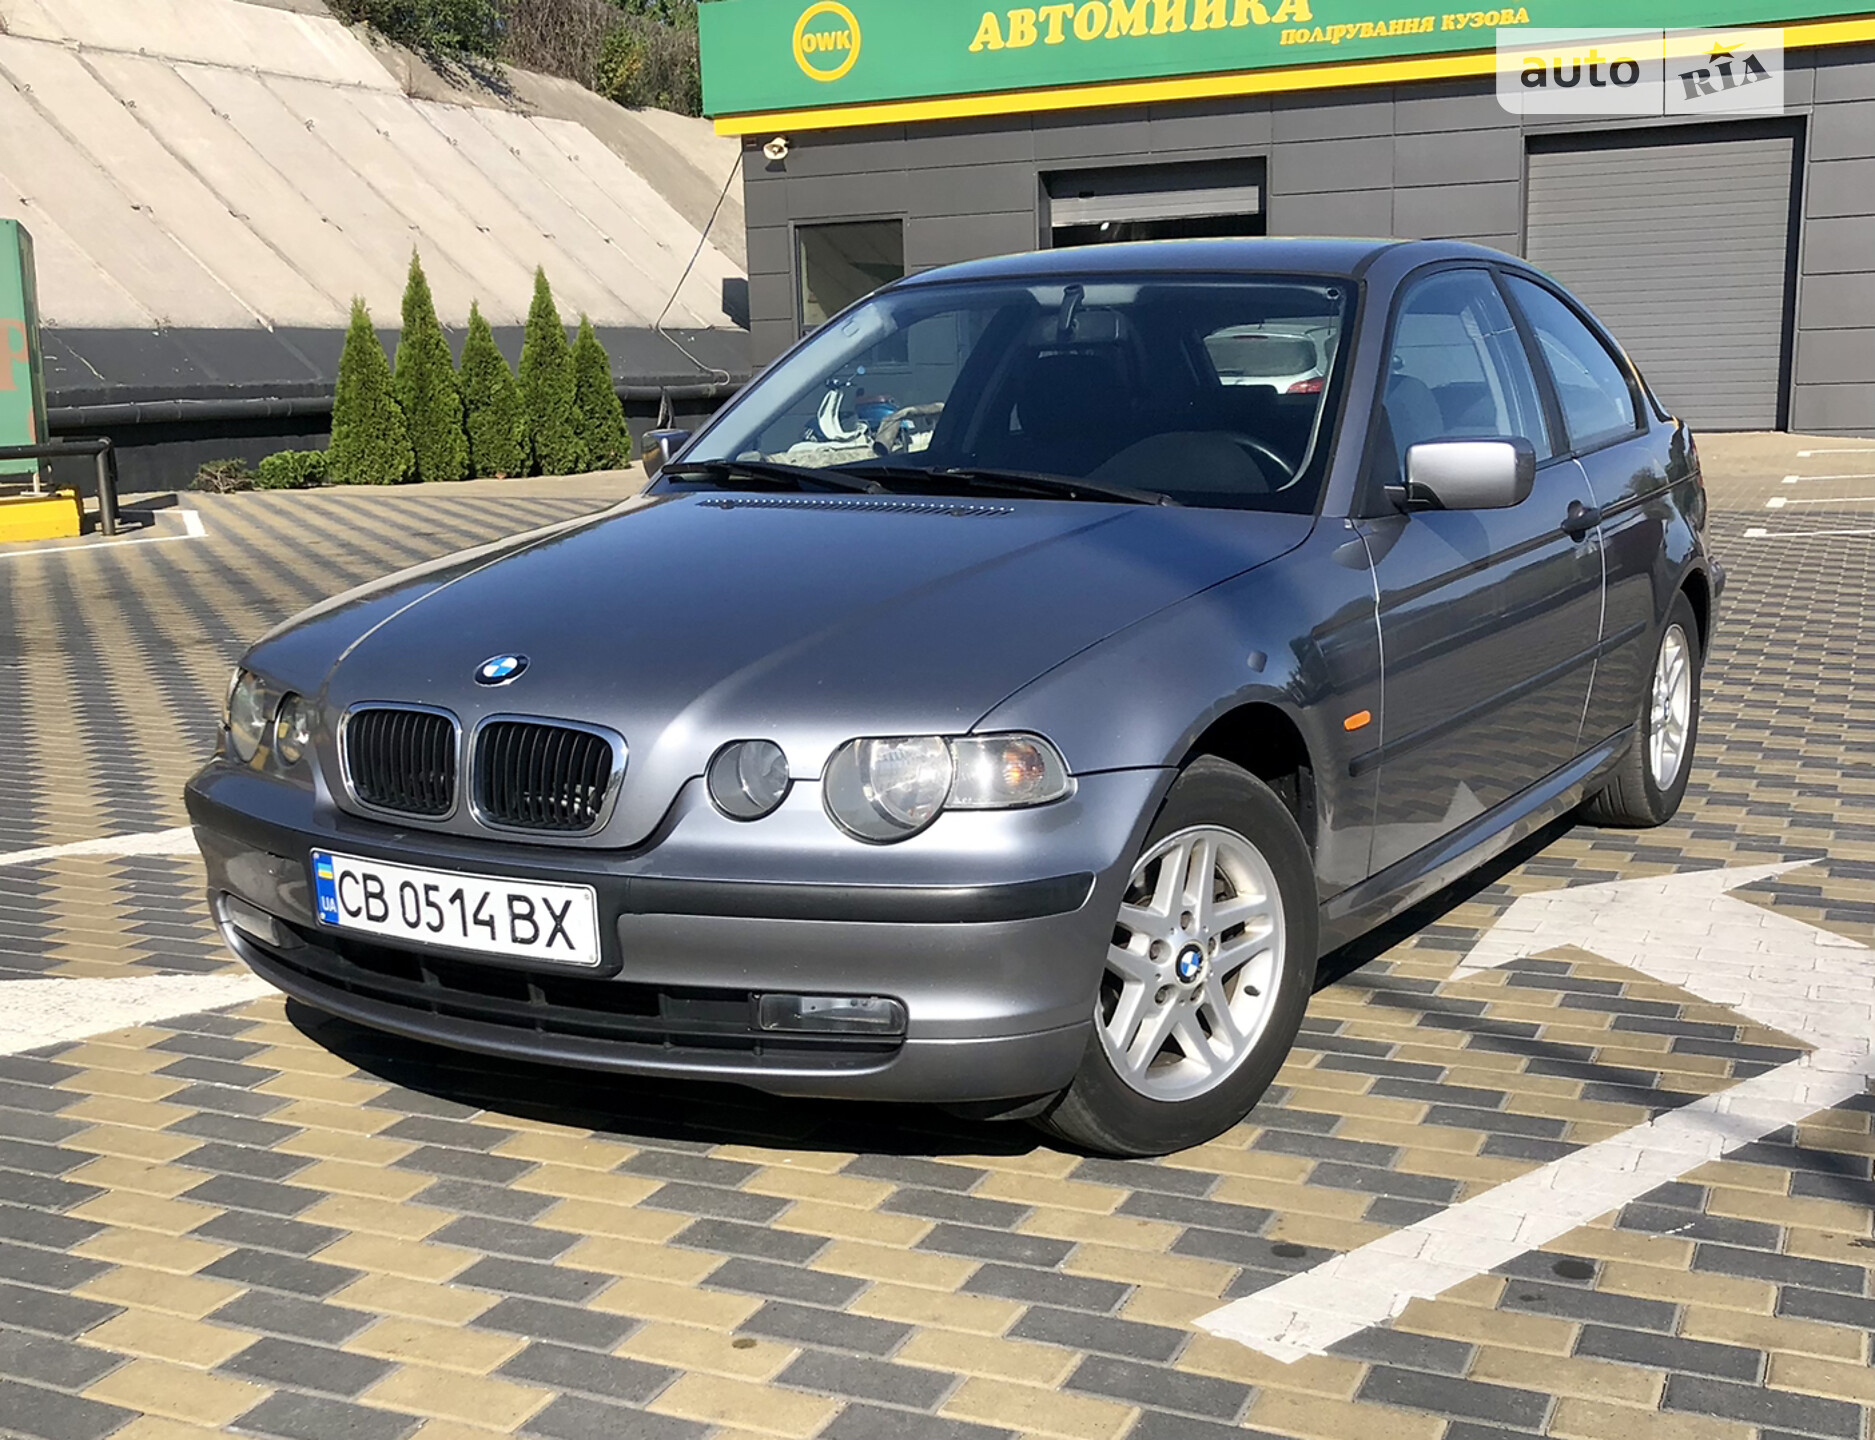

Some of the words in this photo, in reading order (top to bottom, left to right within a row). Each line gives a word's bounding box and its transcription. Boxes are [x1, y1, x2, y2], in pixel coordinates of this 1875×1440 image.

[1441, 7, 1529, 31] КУЗОВА
[802, 30, 852, 52] OWK
[321, 896, 337, 912] UA
[338, 870, 389, 923] CB
[400, 880, 496, 941] 0514
[507, 893, 576, 950] BX
